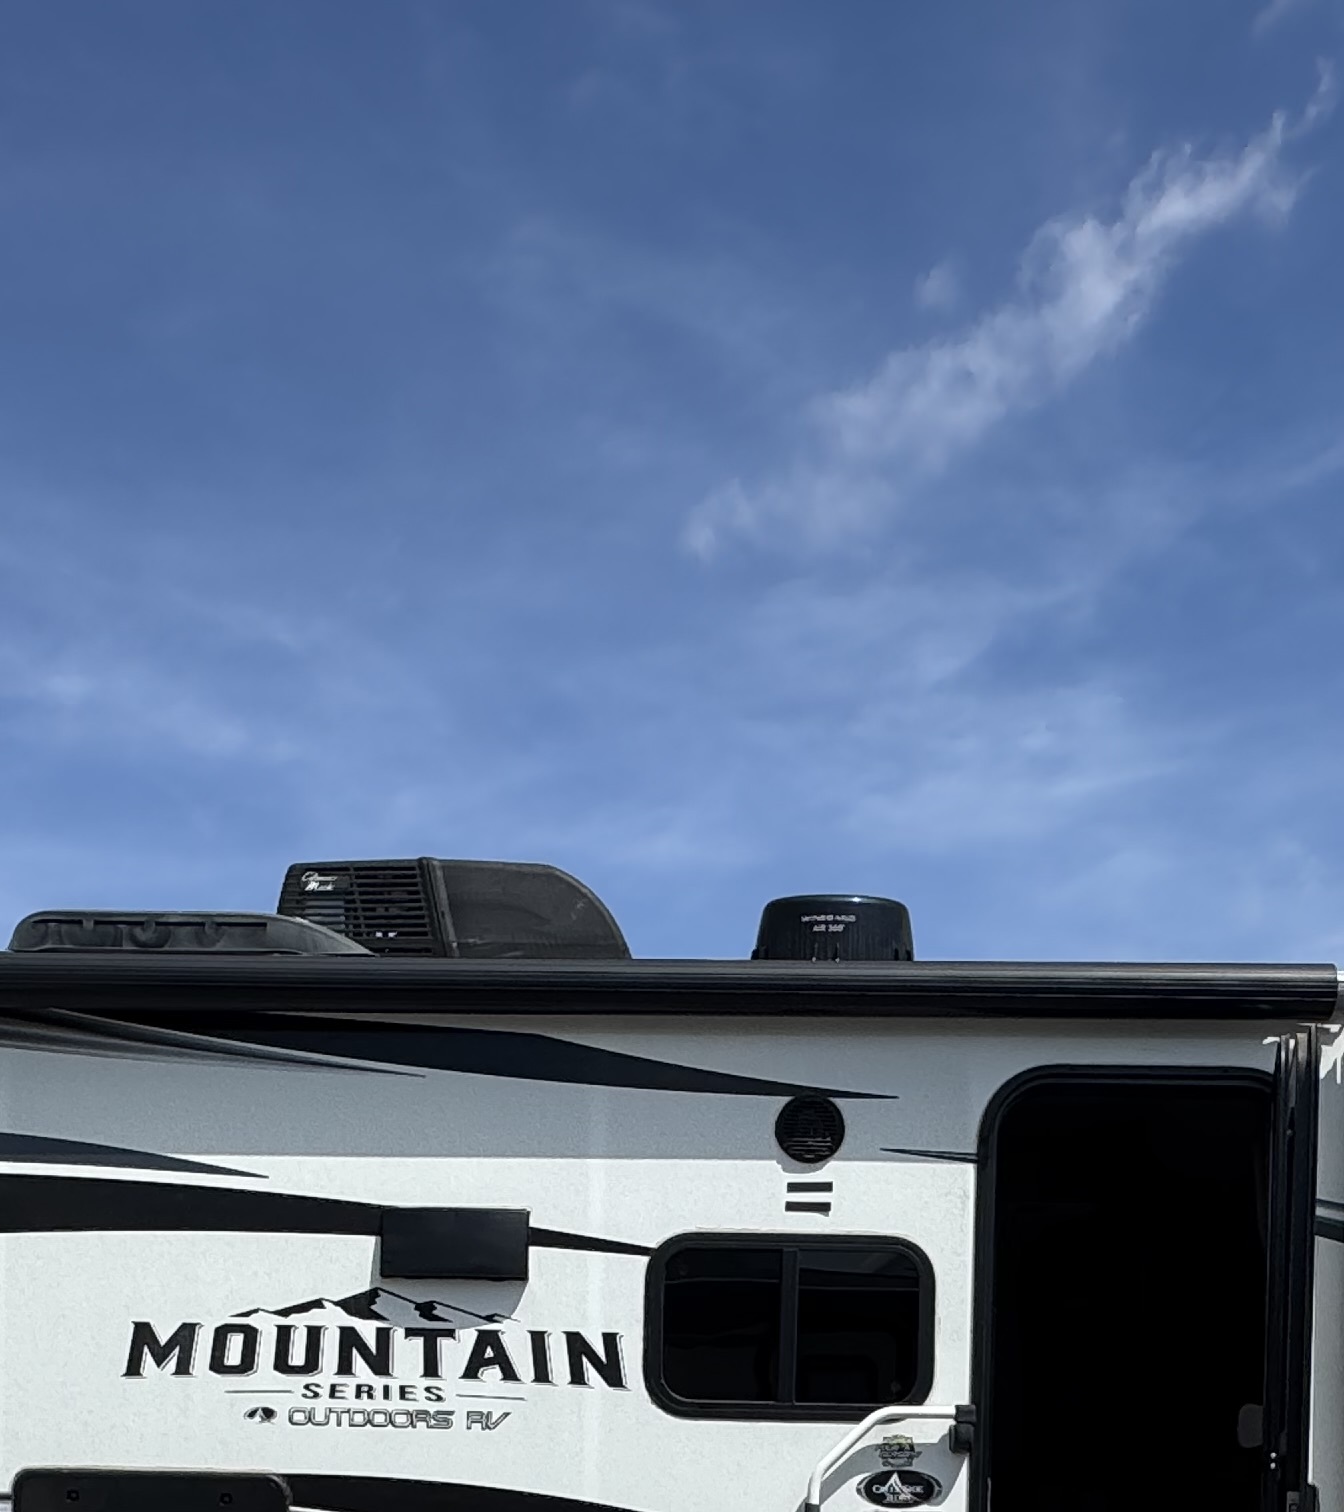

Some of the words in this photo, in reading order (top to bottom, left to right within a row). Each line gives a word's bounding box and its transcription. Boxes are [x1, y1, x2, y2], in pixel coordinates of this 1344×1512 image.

[120, 1320, 633, 1391] MOUNTAIN
[301, 1382, 447, 1403] SERIES
[288, 1406, 455, 1430] OUTDOORS
[466, 1410, 513, 1431] RV
